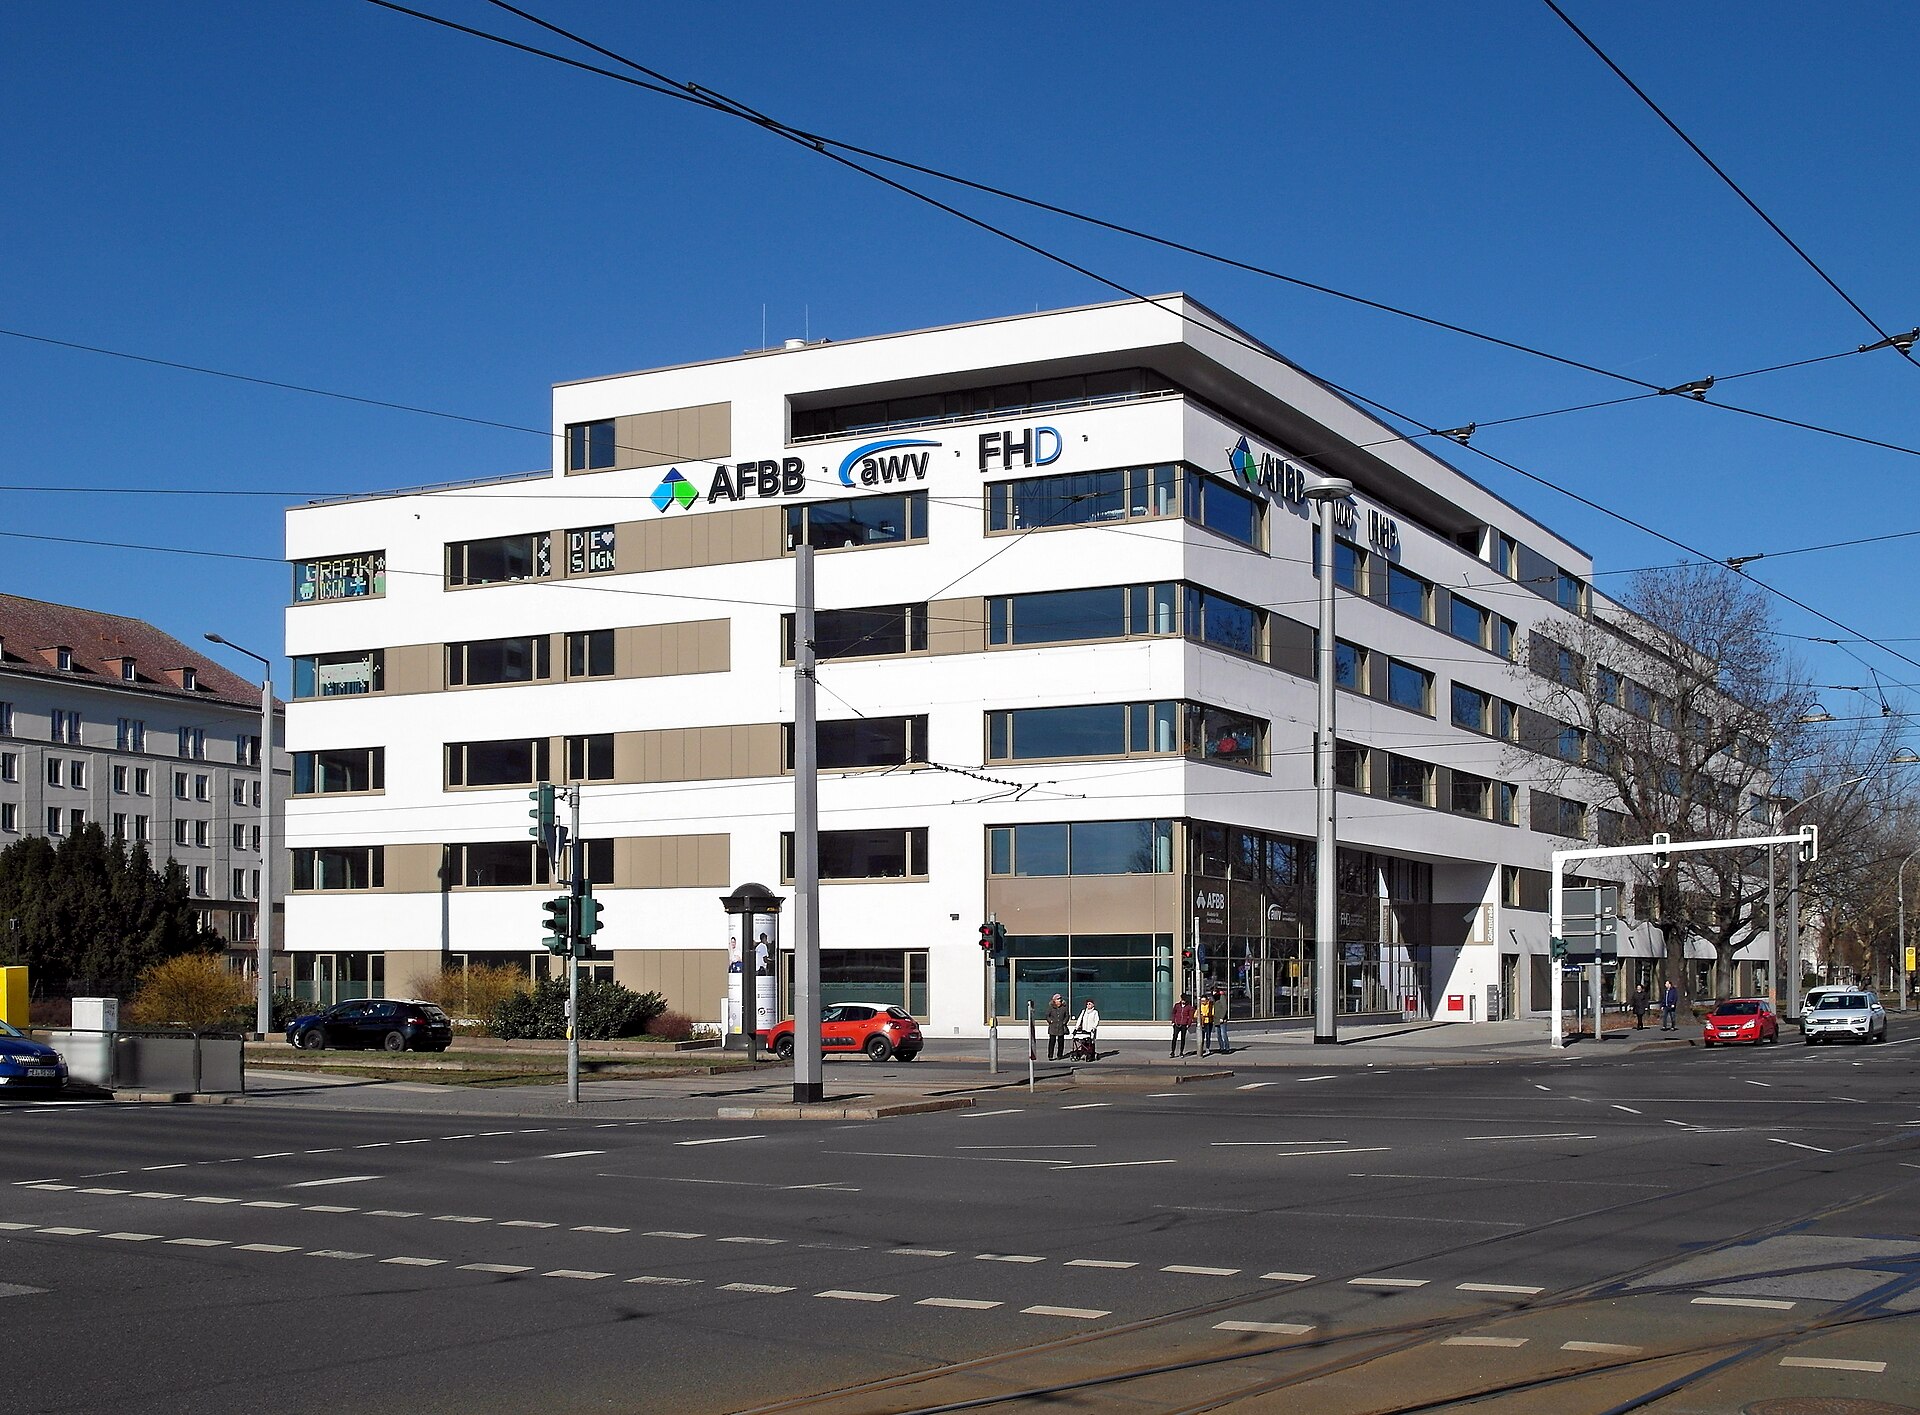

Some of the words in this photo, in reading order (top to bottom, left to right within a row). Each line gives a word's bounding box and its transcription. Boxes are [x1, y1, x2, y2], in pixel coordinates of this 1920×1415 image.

[861, 452, 929, 485] awv
[978, 426, 1063, 472] FHD
[708, 457, 805, 503] AFBB
[1258, 452, 1306, 503] AFBB
[306, 557, 370, 581] GRAFIK
[1206, 892, 1225, 910] AFBB
